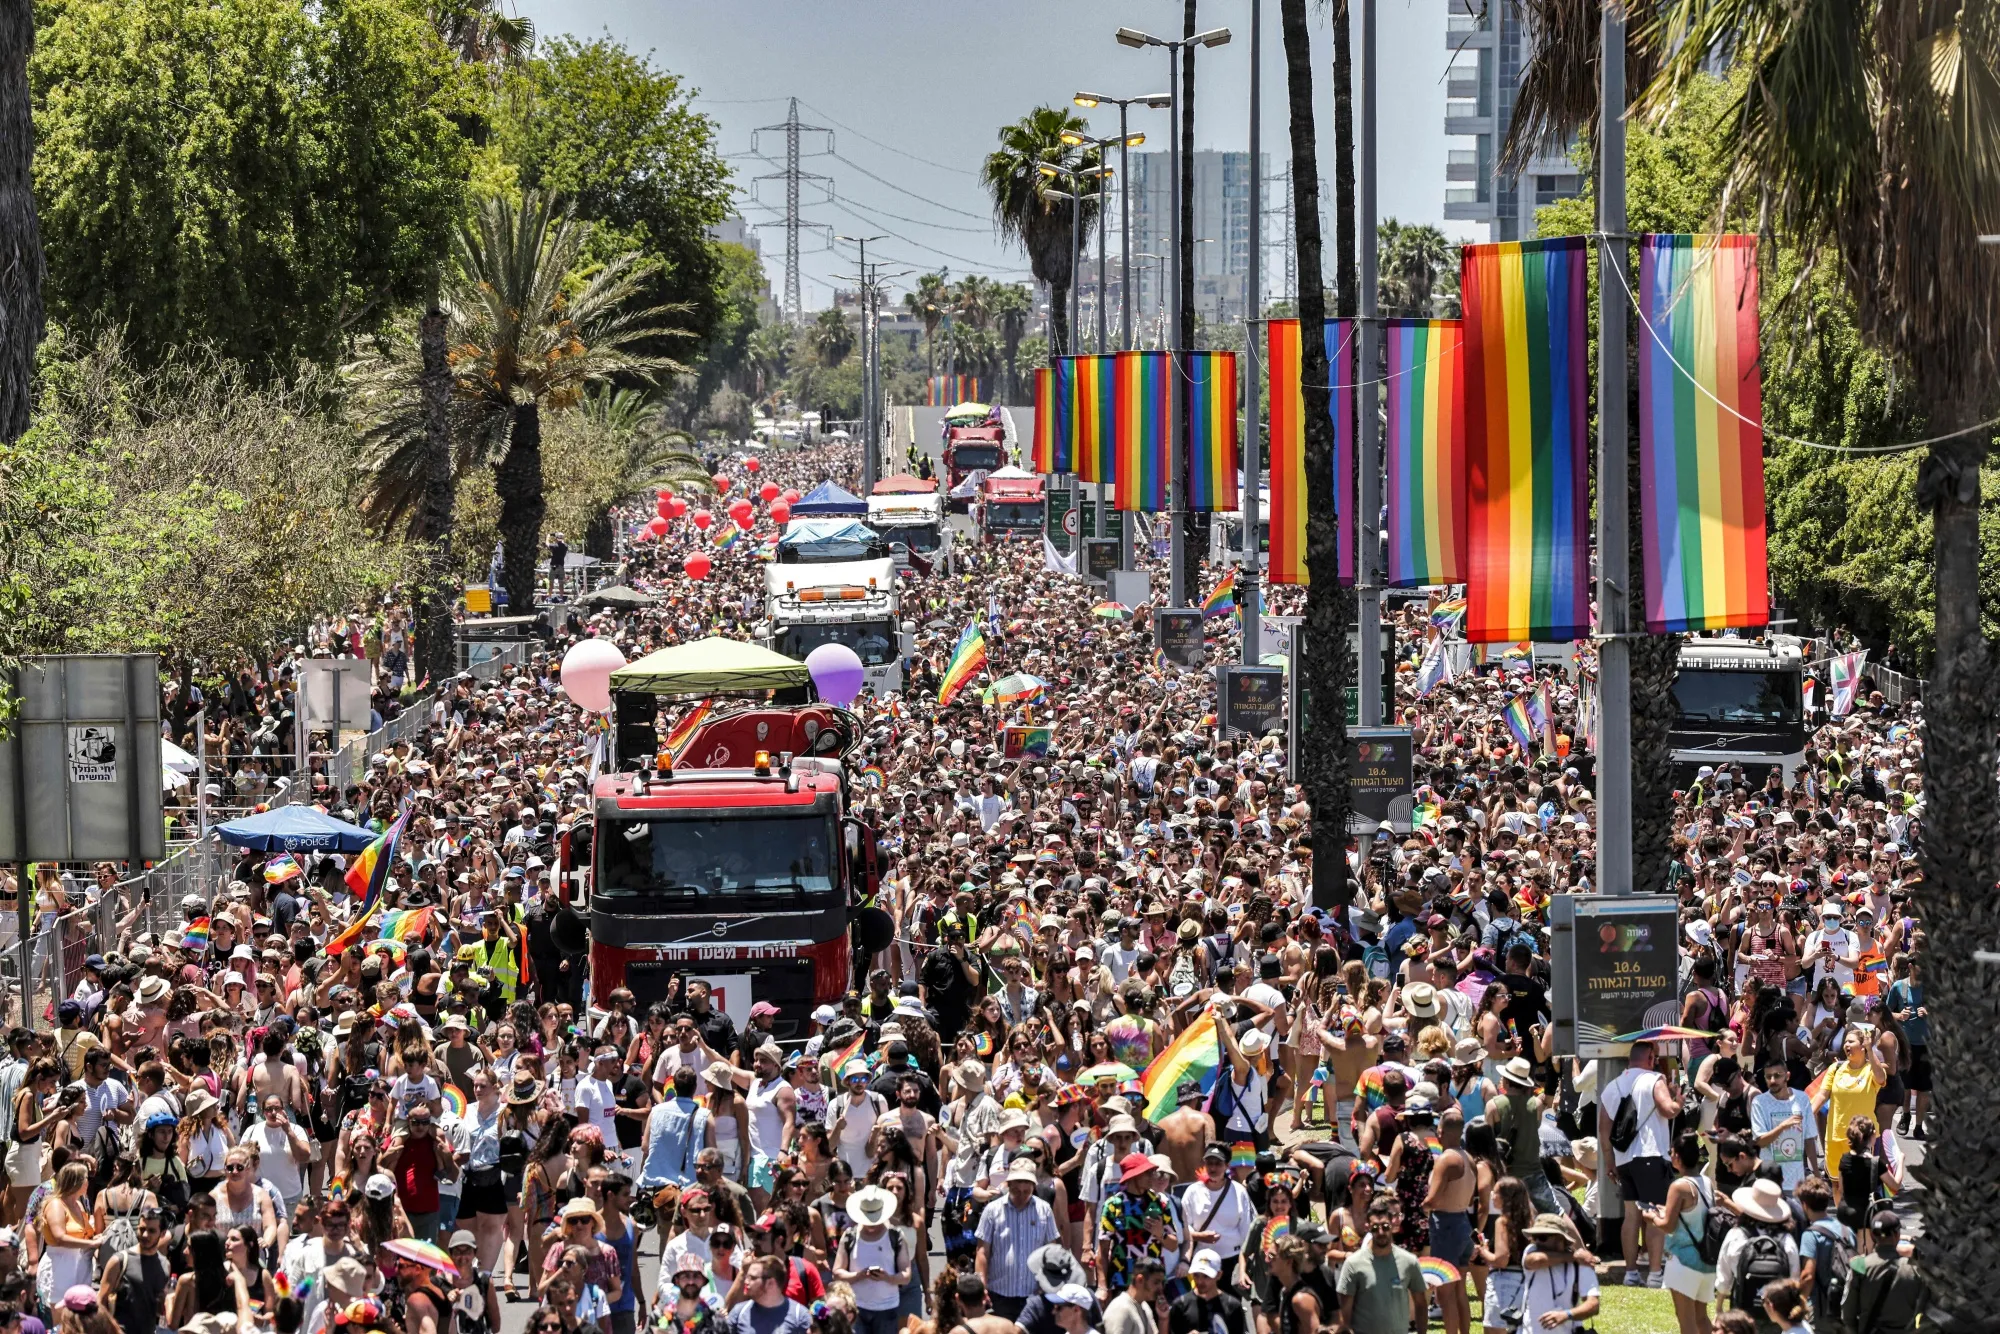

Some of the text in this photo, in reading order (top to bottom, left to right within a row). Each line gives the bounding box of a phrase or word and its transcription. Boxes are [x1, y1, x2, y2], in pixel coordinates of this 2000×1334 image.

[1676, 657, 1781, 670] זהירות מטען חורג
[72, 764, 98, 776] המלך
[1368, 767, 1387, 776] 10.6
[78, 774, 111, 782] המשיח
[1350, 777, 1404, 787] מצעד הגאווה
[300, 837, 330, 847] POLICE
[1626, 928, 1649, 938] גאווה
[655, 945, 798, 961] זהירות מטען חורג
[1613, 961, 1641, 974] 10.6
[1588, 975, 1667, 990] מצעד הגאווה
[1630, 990, 1656, 1000] ספורטק
